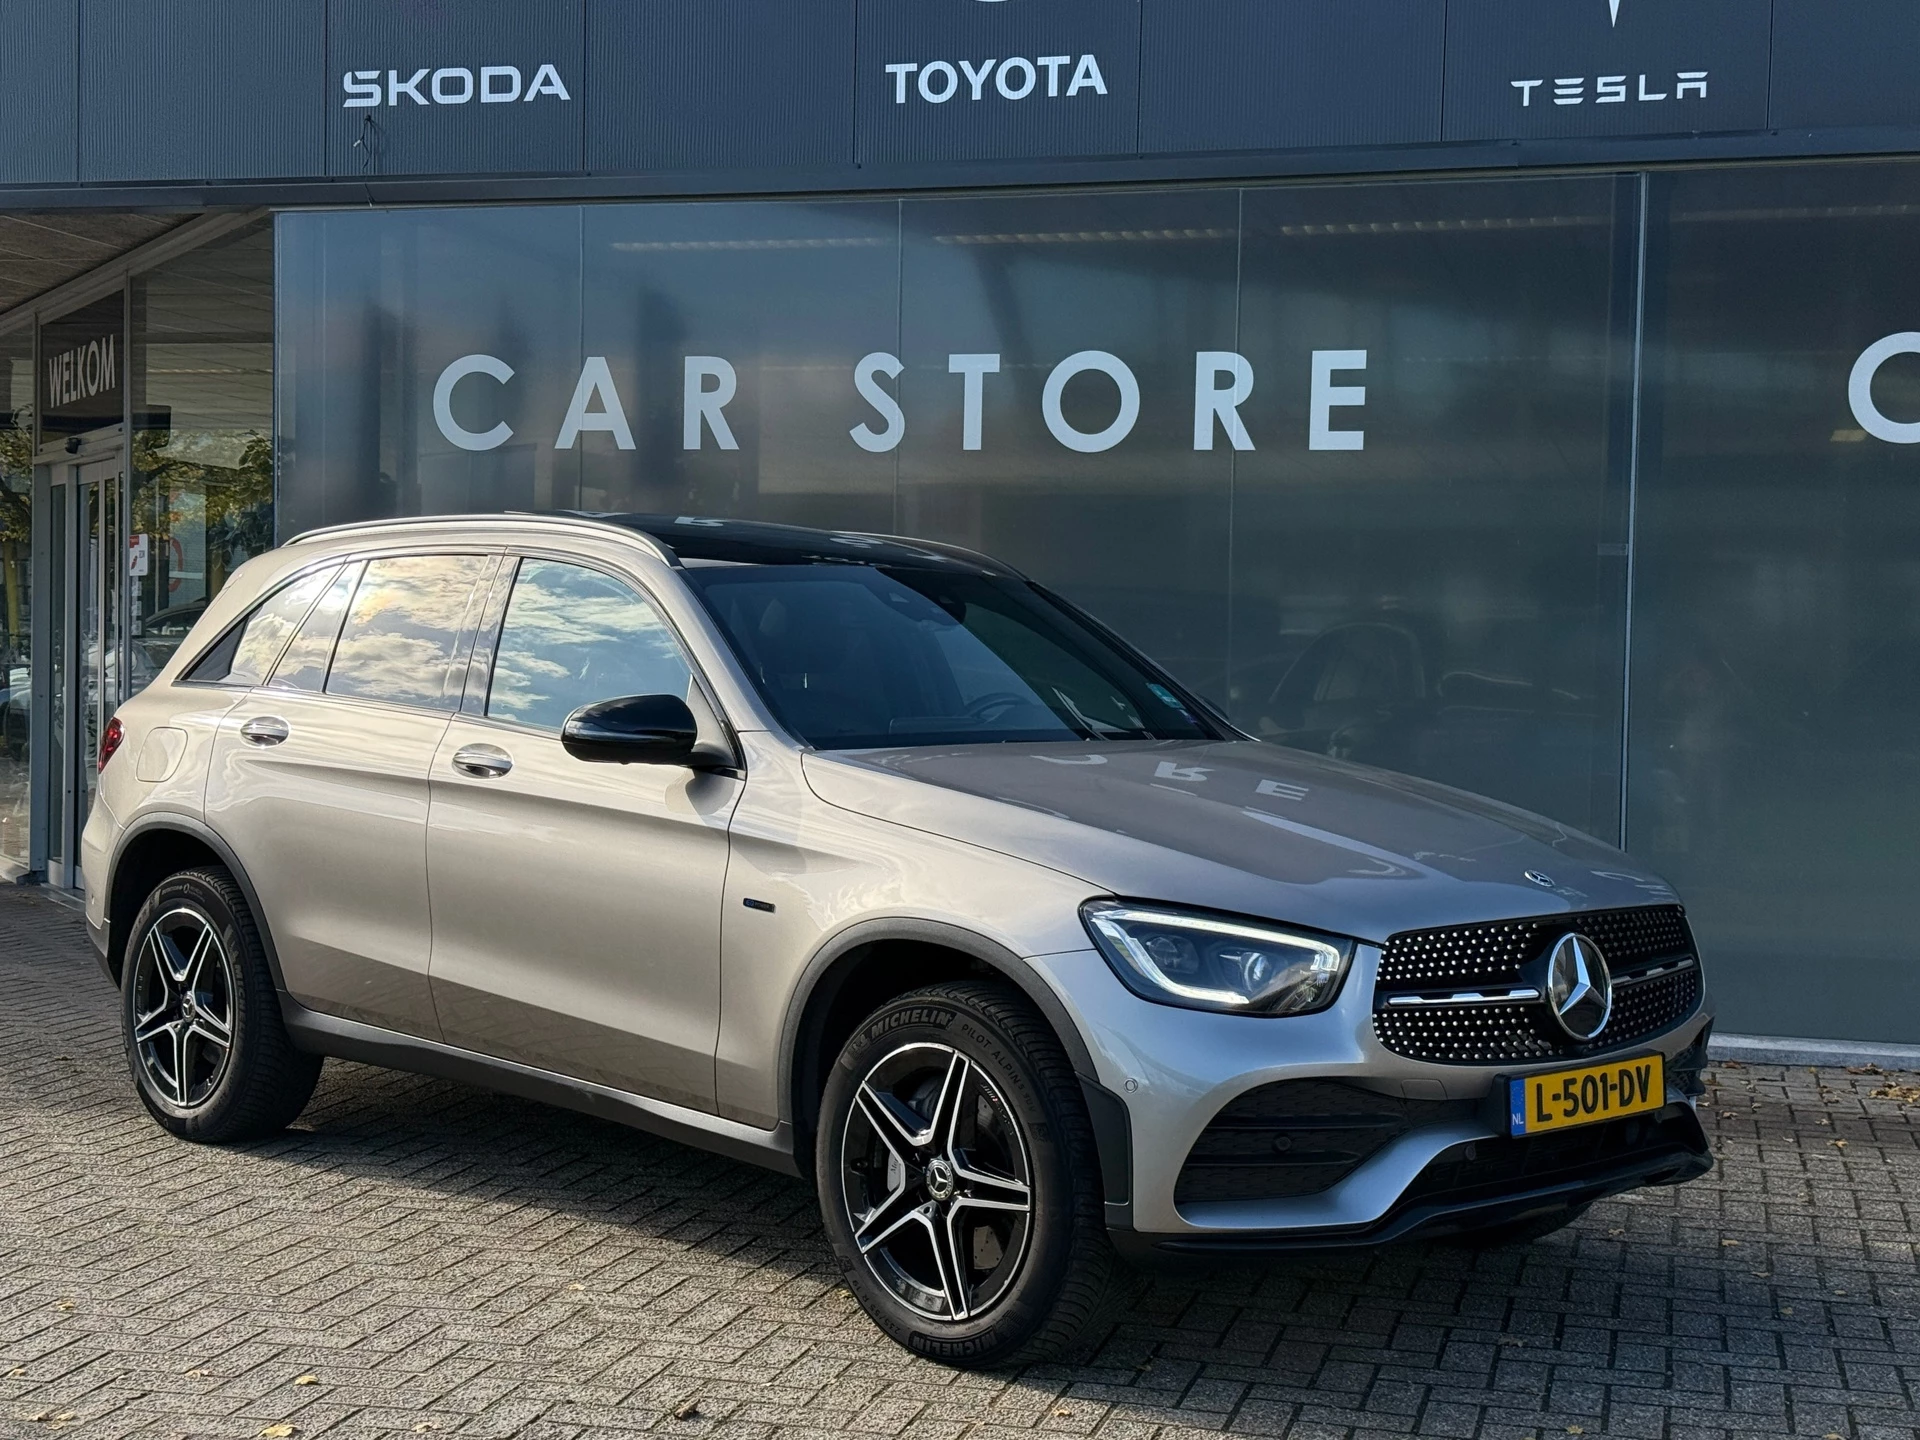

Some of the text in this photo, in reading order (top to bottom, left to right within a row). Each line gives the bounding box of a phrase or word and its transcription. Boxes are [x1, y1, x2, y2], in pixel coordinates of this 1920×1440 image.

[343, 64, 571, 108] SKODA
[885, 54, 1109, 104] TOYOTA
[1510, 71, 1708, 107] TESLA
[49, 334, 116, 409] WELKOM
[433, 349, 1369, 454] CAR STORE
[871, 1009, 952, 1040] MICHELIN
[962, 1023, 992, 1048] PILOT
[991, 1051, 1020, 1084] ALPIN
[1536, 1064, 1651, 1123] L-501-DV
[1512, 1113, 1524, 1125] NL
[851, 1279, 862, 1292] 19
[869, 1303, 901, 1335] 235/55
[913, 1330, 998, 1357] MICHELIN
